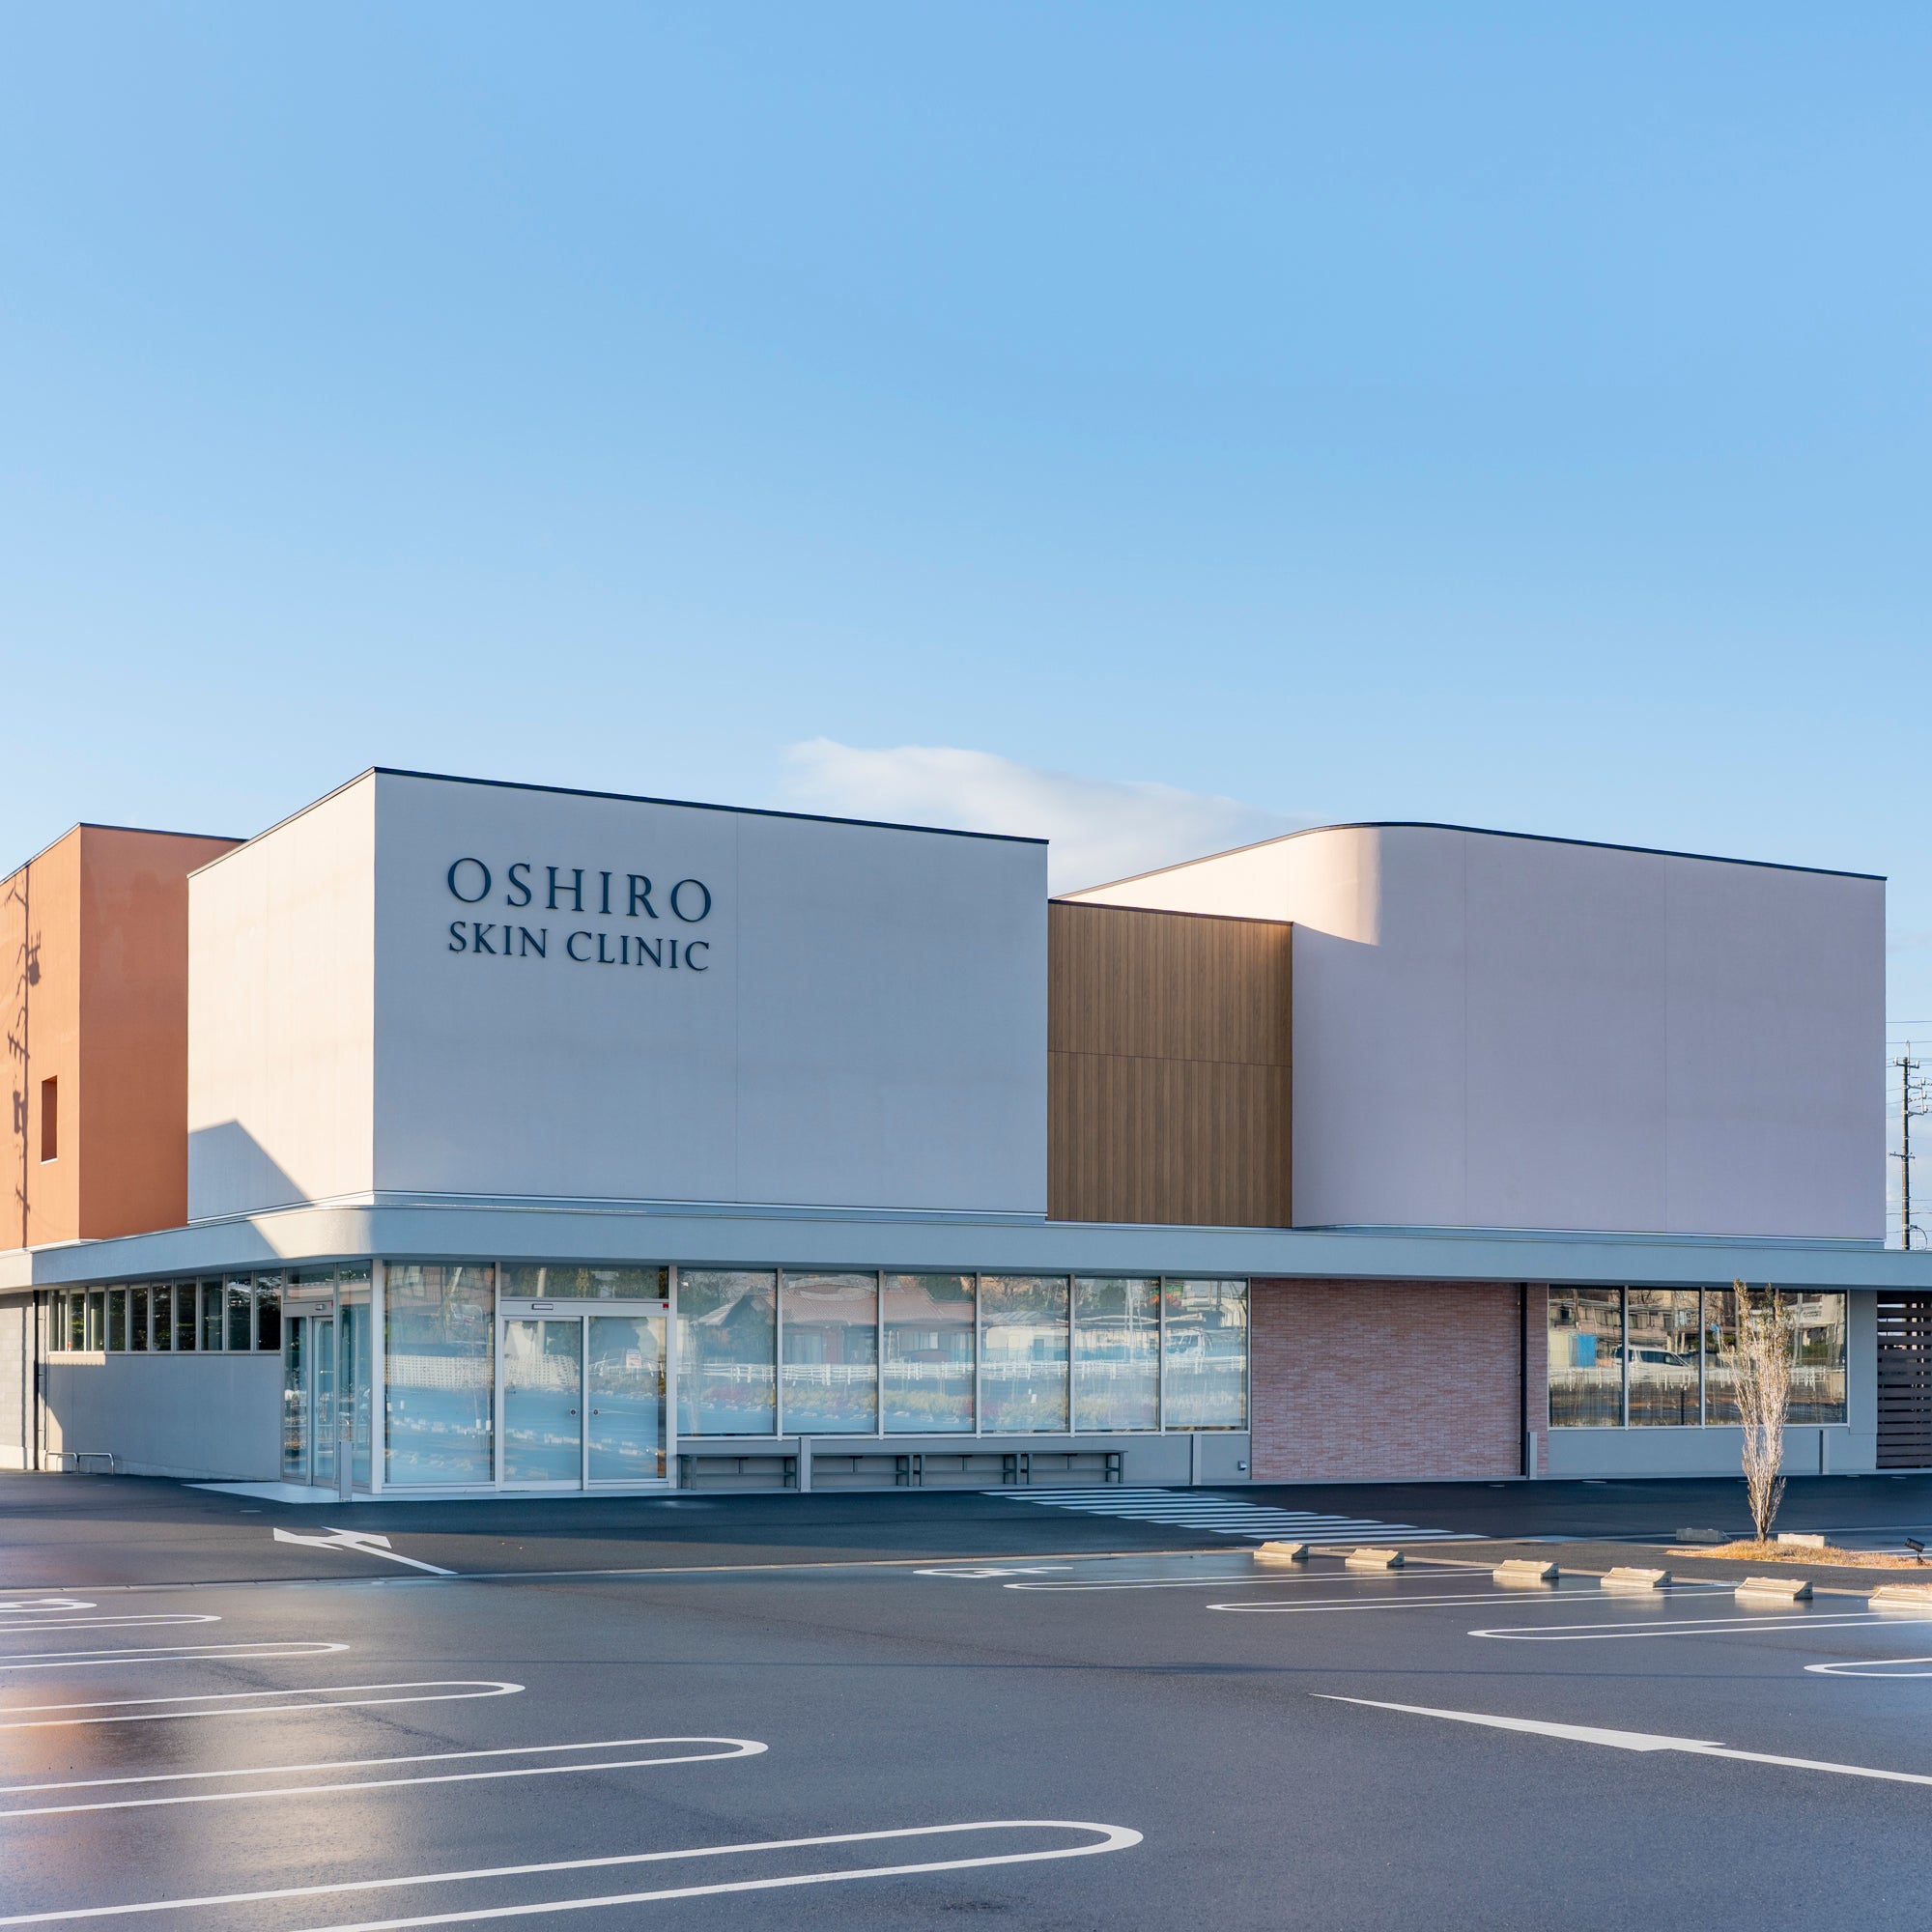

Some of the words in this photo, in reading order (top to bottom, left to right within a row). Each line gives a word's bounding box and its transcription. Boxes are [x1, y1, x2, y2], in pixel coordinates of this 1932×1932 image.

[446, 857, 712, 923] OSHIRO
[448, 921, 549, 958] SKIN
[565, 931, 710, 972] CLINIC
